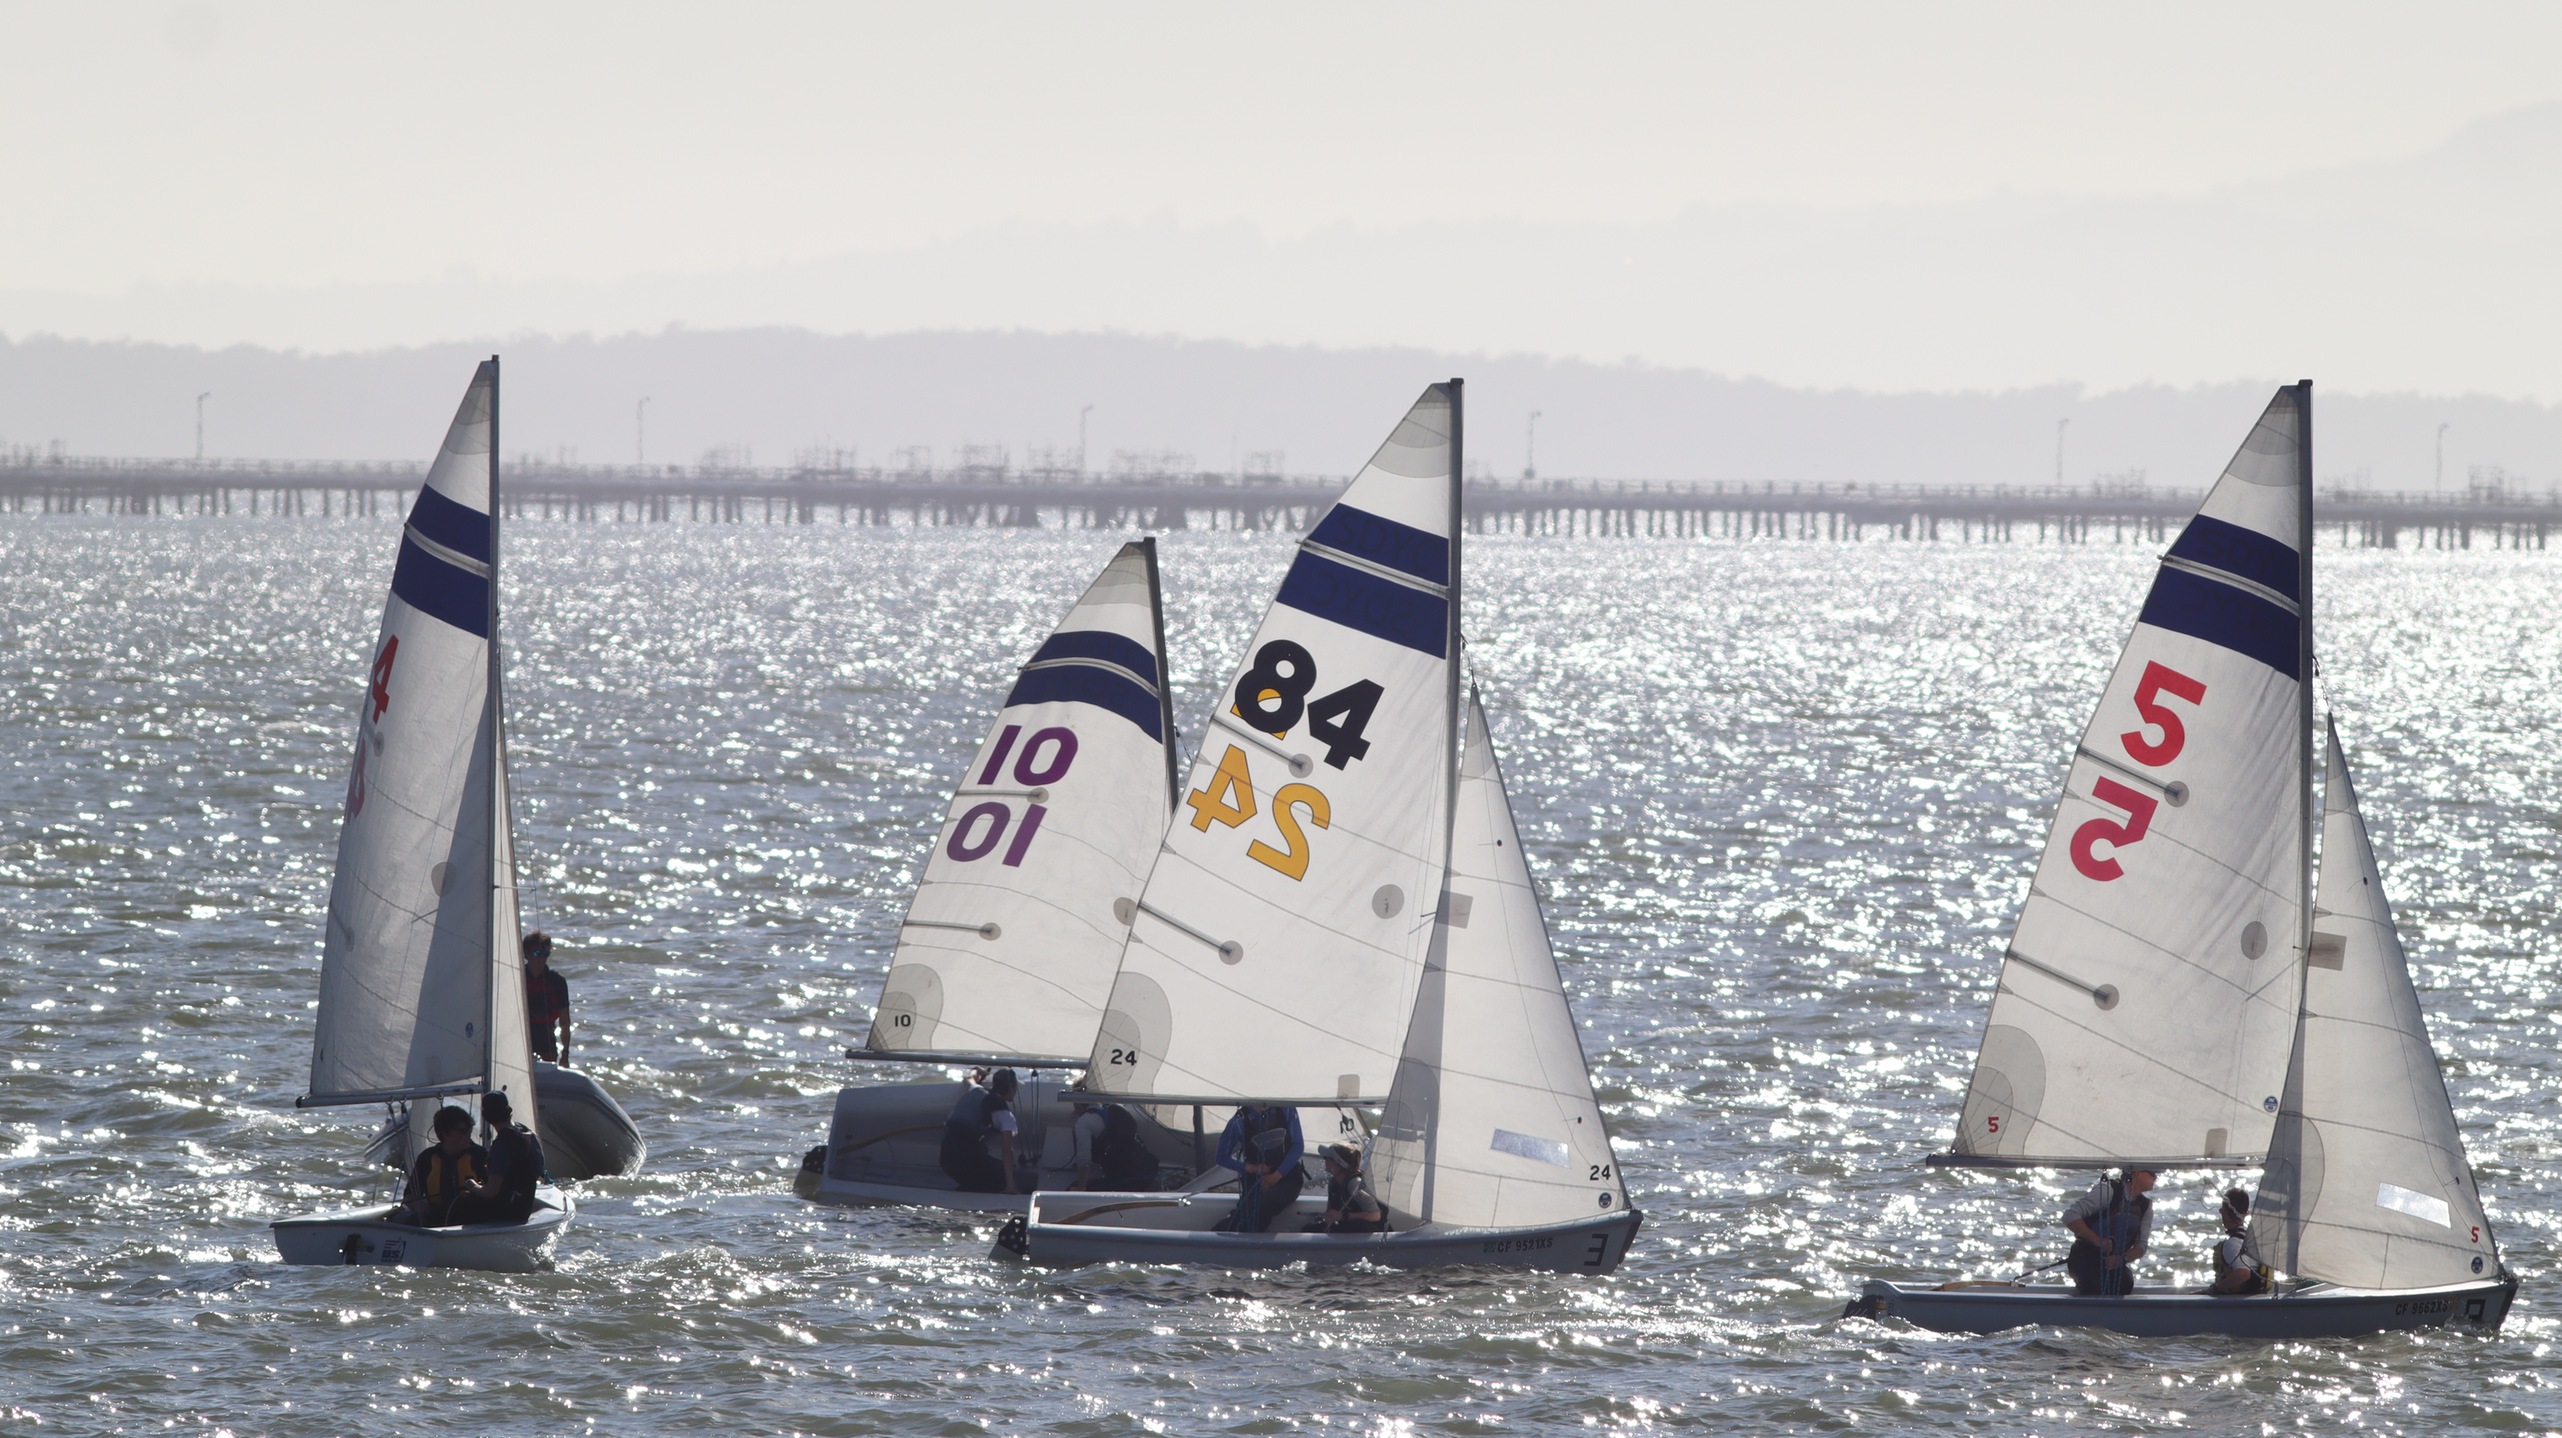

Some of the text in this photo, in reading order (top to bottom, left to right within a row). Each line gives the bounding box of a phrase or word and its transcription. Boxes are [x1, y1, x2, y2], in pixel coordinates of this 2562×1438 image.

[372, 634, 399, 725] 4
[1235, 639, 1385, 771] 84
[2120, 660, 2207, 767] 5
[977, 724, 1078, 787] 10
[894, 1014, 911, 1028] 10
[1110, 1048, 1138, 1066] 24
[1987, 1116, 2000, 1133] 5
[1589, 1163, 1611, 1182] 24
[2470, 1225, 2481, 1244] 5
[1497, 1241, 1512, 1253] CF
[2395, 1303, 2410, 1316] CF
